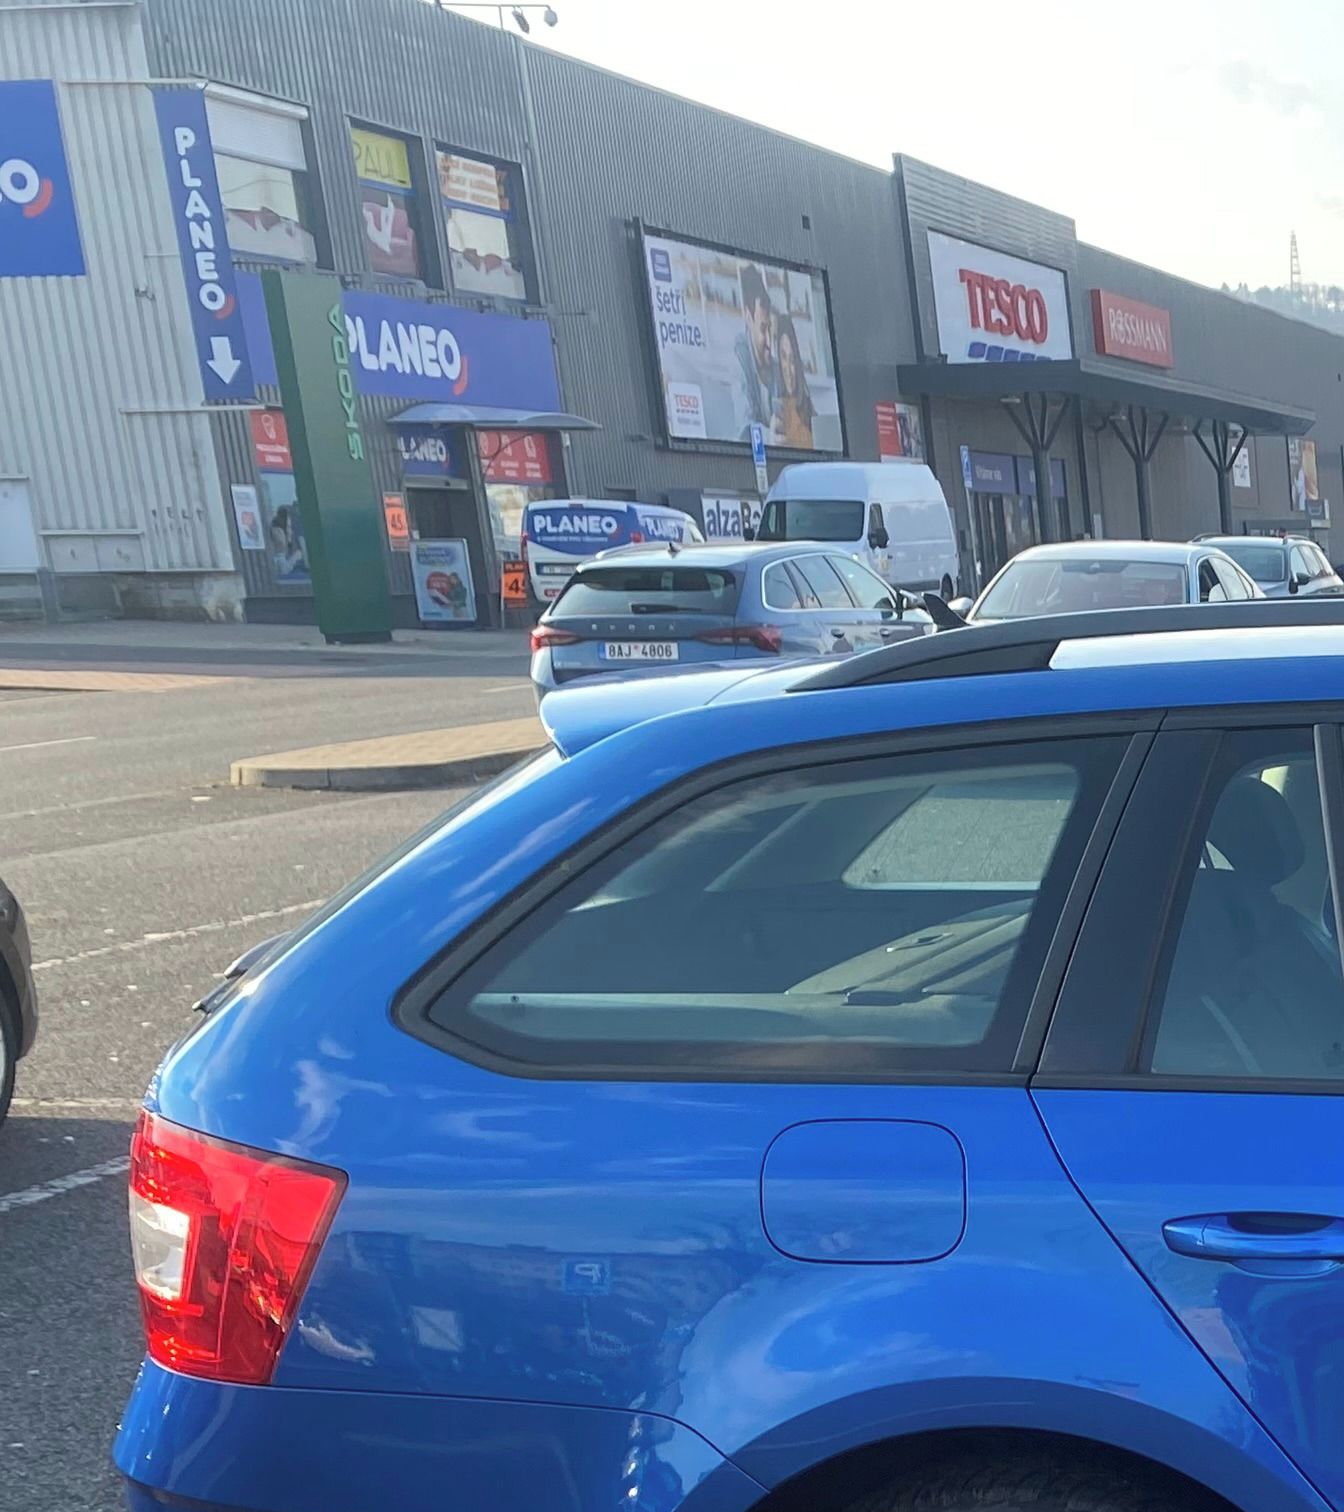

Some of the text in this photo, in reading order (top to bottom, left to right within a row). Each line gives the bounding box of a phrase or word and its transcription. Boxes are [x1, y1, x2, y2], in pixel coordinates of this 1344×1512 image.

[174, 126, 226, 311] PLANEO
[656, 286, 688, 316] šetří
[959, 268, 1047, 344] TESCO
[673, 393, 699, 409] TESCO
[533, 515, 617, 534] PLANEO
